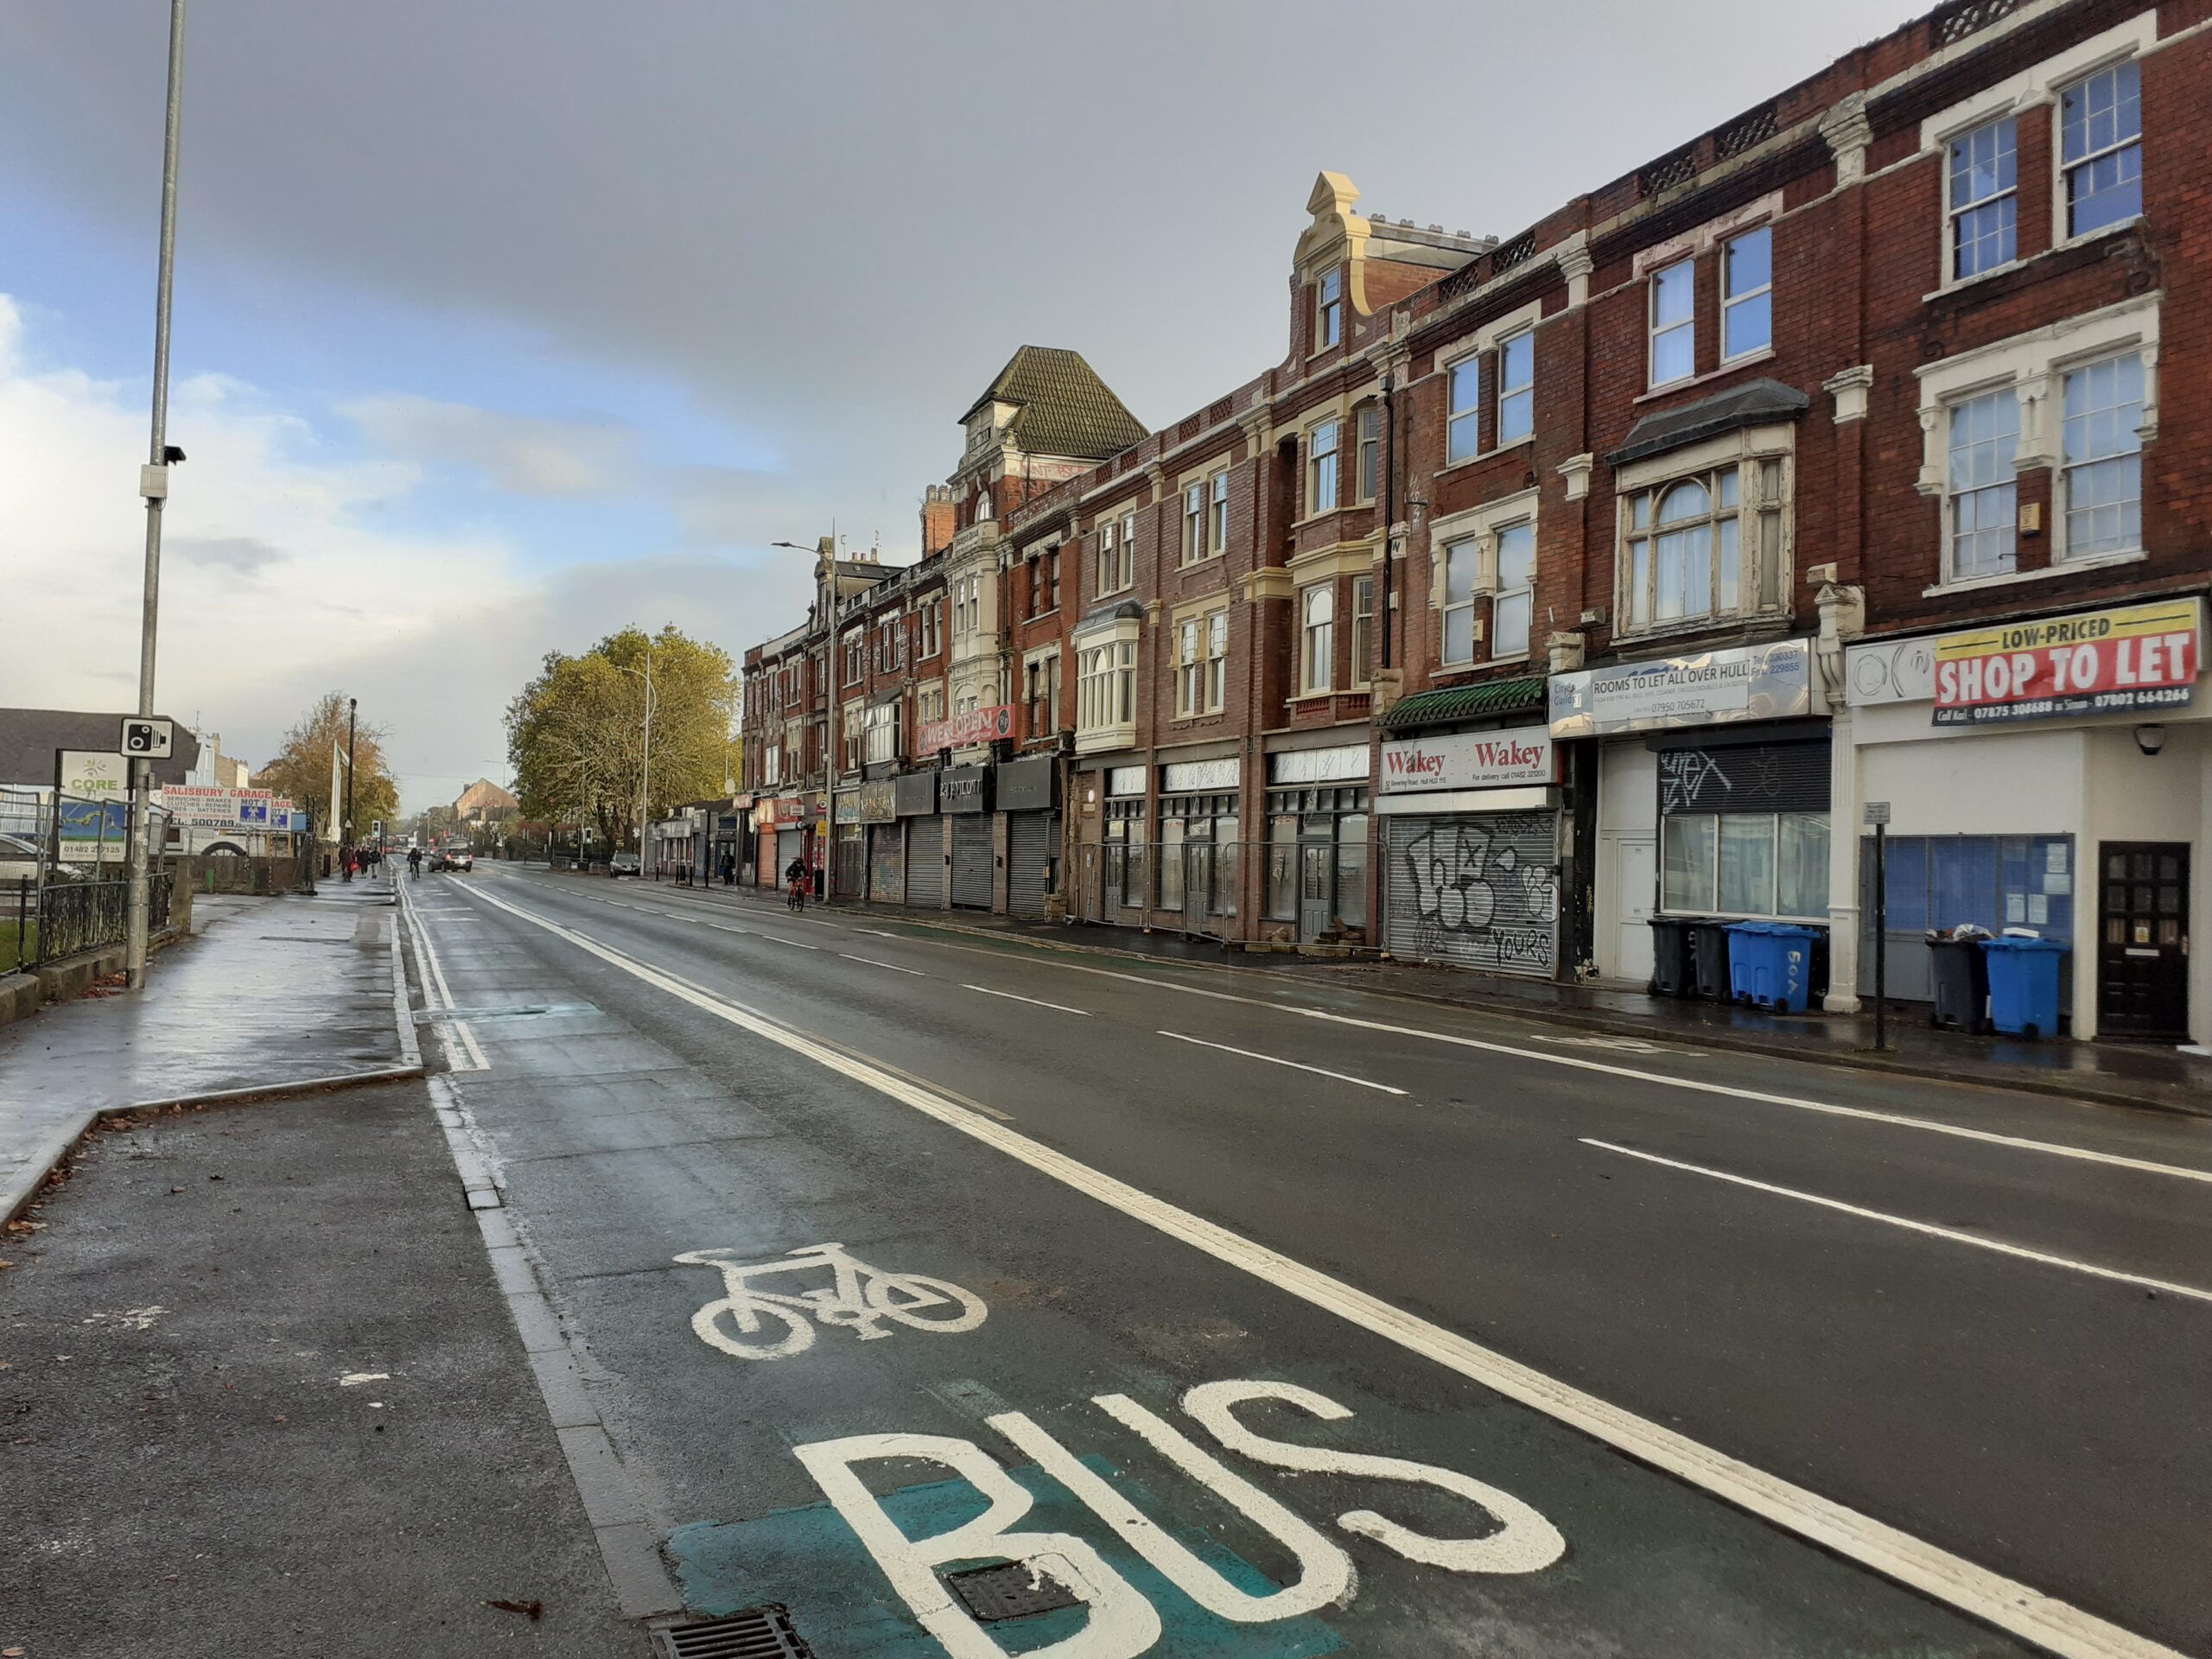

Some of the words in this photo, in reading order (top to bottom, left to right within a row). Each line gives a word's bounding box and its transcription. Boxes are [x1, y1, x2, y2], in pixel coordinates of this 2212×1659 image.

[2002, 618, 2110, 649] LOW-PRICED
[1594, 678, 1630, 694] ROOMS
[1632, 677, 1646, 690] TO
[1649, 674, 1665, 688] LET
[1668, 671, 1686, 685] ALL
[1688, 667, 1717, 683] OVER
[1720, 664, 1749, 679] HULL
[1940, 653, 2036, 703] SHOP
[2050, 643, 2099, 691] TO
[2116, 632, 2190, 684] LET
[1554, 694, 1575, 705] Guilds
[1651, 702, 1675, 713] 07950
[1677, 698, 1705, 710] 705672
[1974, 705, 2008, 719] 07875
[2094, 693, 2133, 707] 07802
[2137, 689, 2190, 703] 664266
[956, 710, 992, 734] OPEN
[1386, 750, 1446, 777] Wakey
[1475, 741, 1545, 769] Wakey
[72, 779, 118, 790] CORE
[1482, 772, 1499, 781] delivery
[164, 787, 224, 797] SALISBURY
[230, 789, 271, 798] GARAGE
[192, 818, 234, 827] 500789
[1492, 929, 1549, 968] YOURS
[792, 1379, 1567, 1659] BUS
